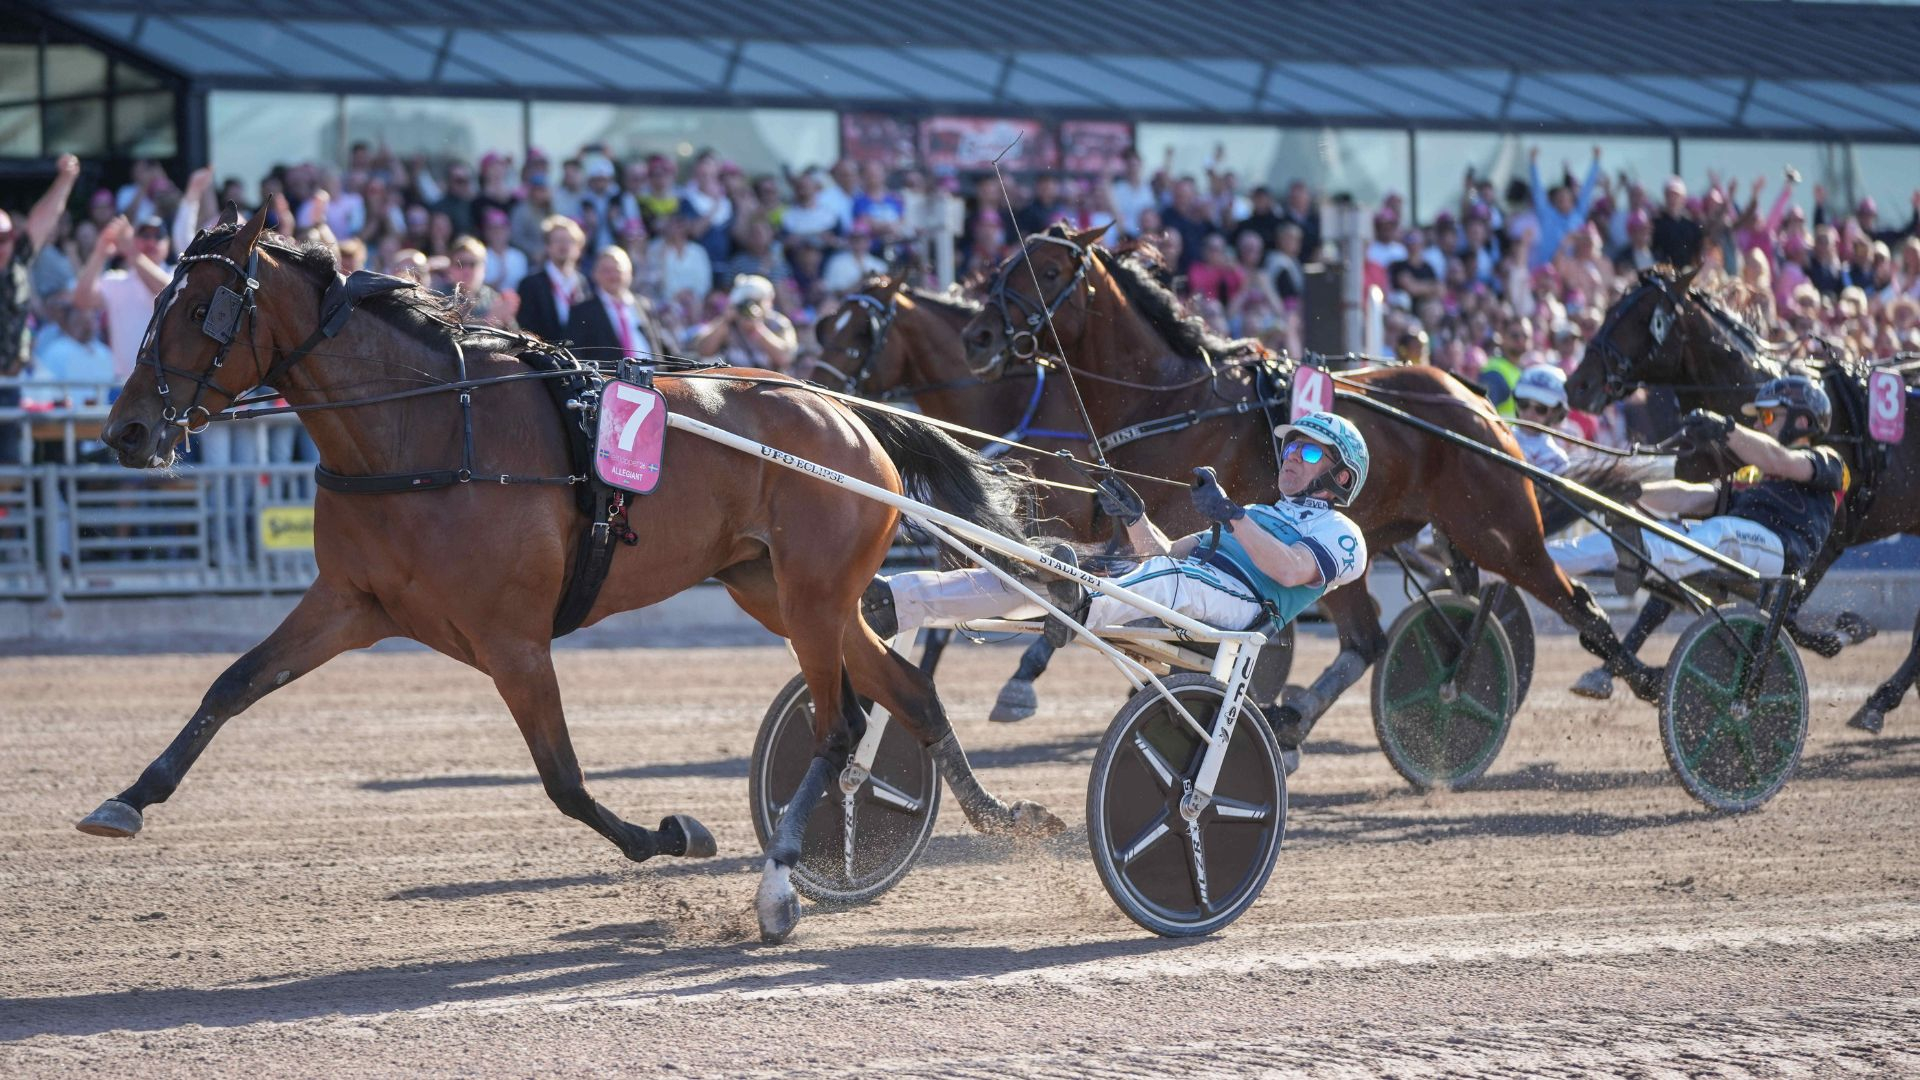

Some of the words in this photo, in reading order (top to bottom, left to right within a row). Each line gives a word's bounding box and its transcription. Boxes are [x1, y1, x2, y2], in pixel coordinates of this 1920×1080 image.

[1299, 371, 1324, 414] 4
[1877, 374, 1899, 420] 3
[616, 384, 656, 452] 7
[611, 466, 643, 481] ALLEGIANT
[760, 445, 795, 465] UFO
[796, 459, 845, 484] ECLIPSE
[1039, 554, 1077, 577] STALL
[1079, 571, 1104, 588] ZET
